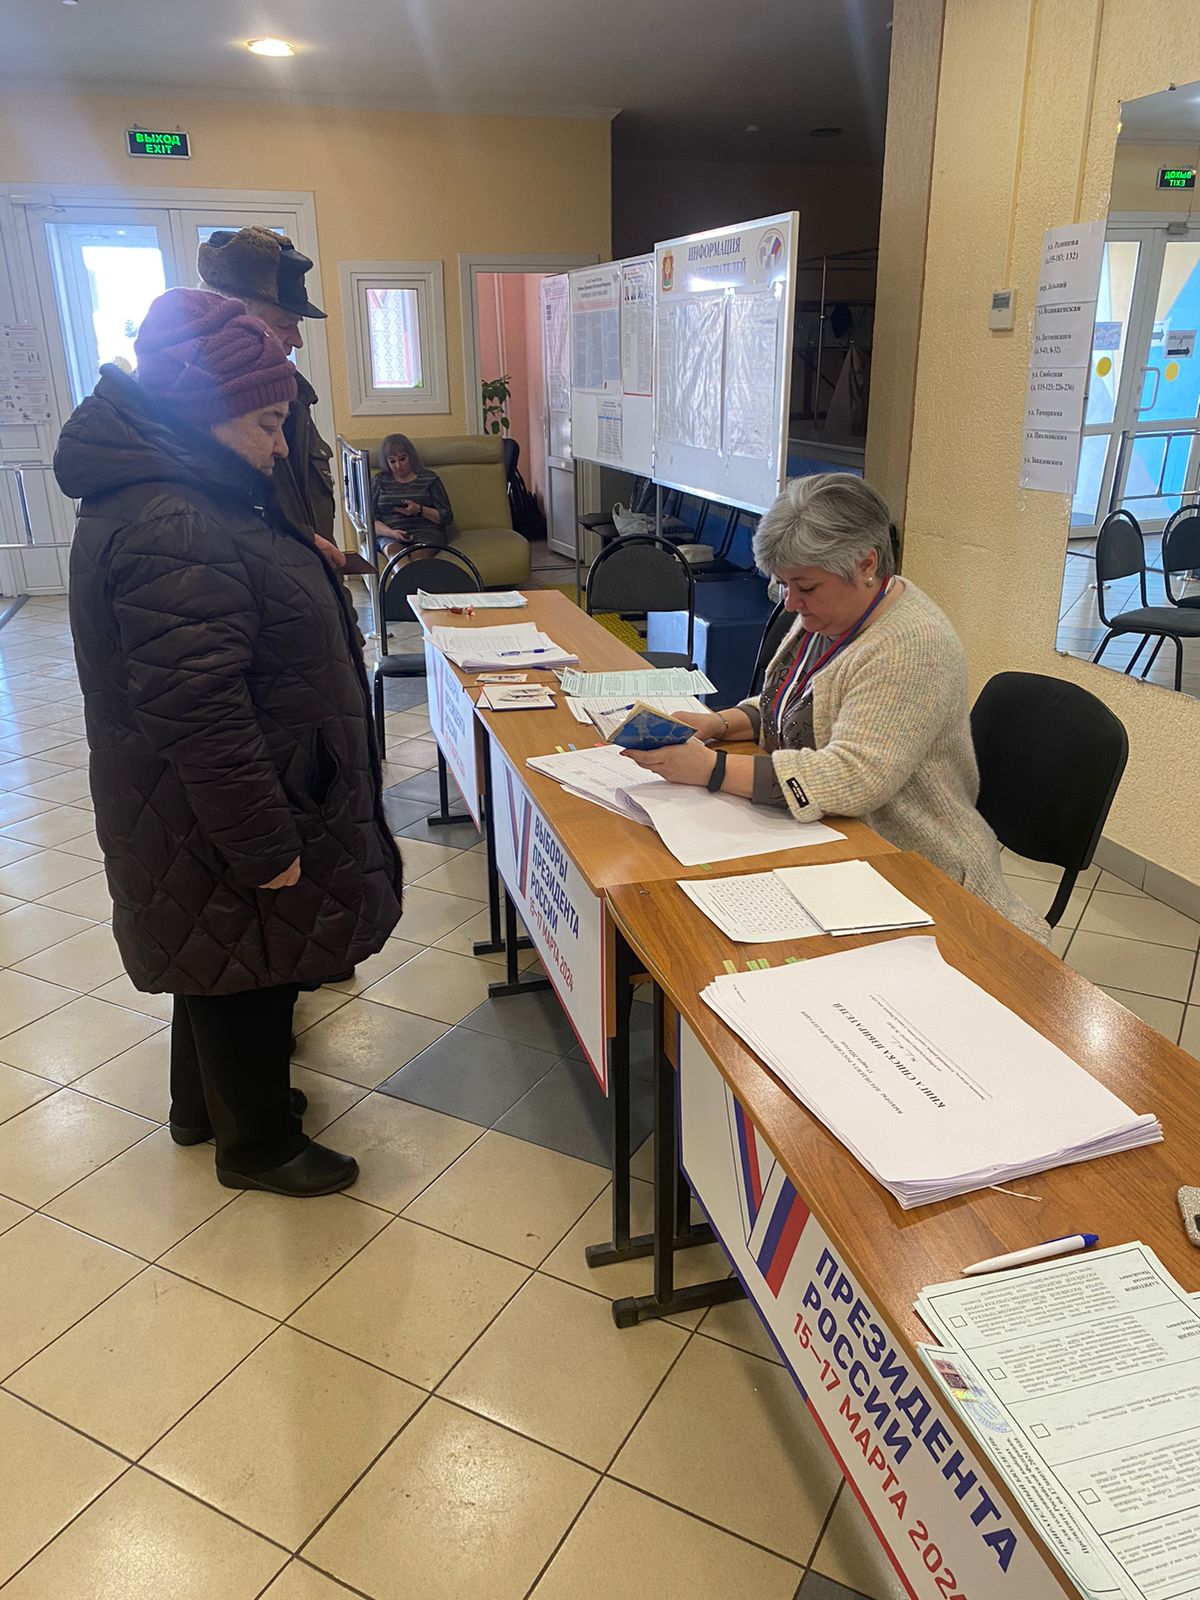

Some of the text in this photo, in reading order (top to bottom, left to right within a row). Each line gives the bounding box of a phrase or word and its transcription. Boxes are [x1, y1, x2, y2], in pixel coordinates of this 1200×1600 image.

[135, 133, 180, 146] ВЫХОД
[146, 144, 172, 154] EXIT
[688, 237, 741, 261] ИНФОРМАЦИЯ
[535, 815, 568, 883] ВЫБОРЫ
[531, 871, 559, 935] РОССИИ
[533, 843, 580, 940] ПРЕЗИДЕНТА
[542, 921, 560, 967] МАРТА
[559, 956, 574, 993] 2024
[832, 1002, 885, 1050] ИЗБИРАТЕЛЕЙ
[882, 1049, 917, 1081] СПИСКА
[915, 1081, 946, 1108] КНИГА
[802, 1281, 912, 1465] РОССИИ
[815, 1247, 1018, 1574] ПРЕЗИДЕНТА
[839, 1395, 908, 1520] МАРТА
[908, 1520, 968, 1600] 202
